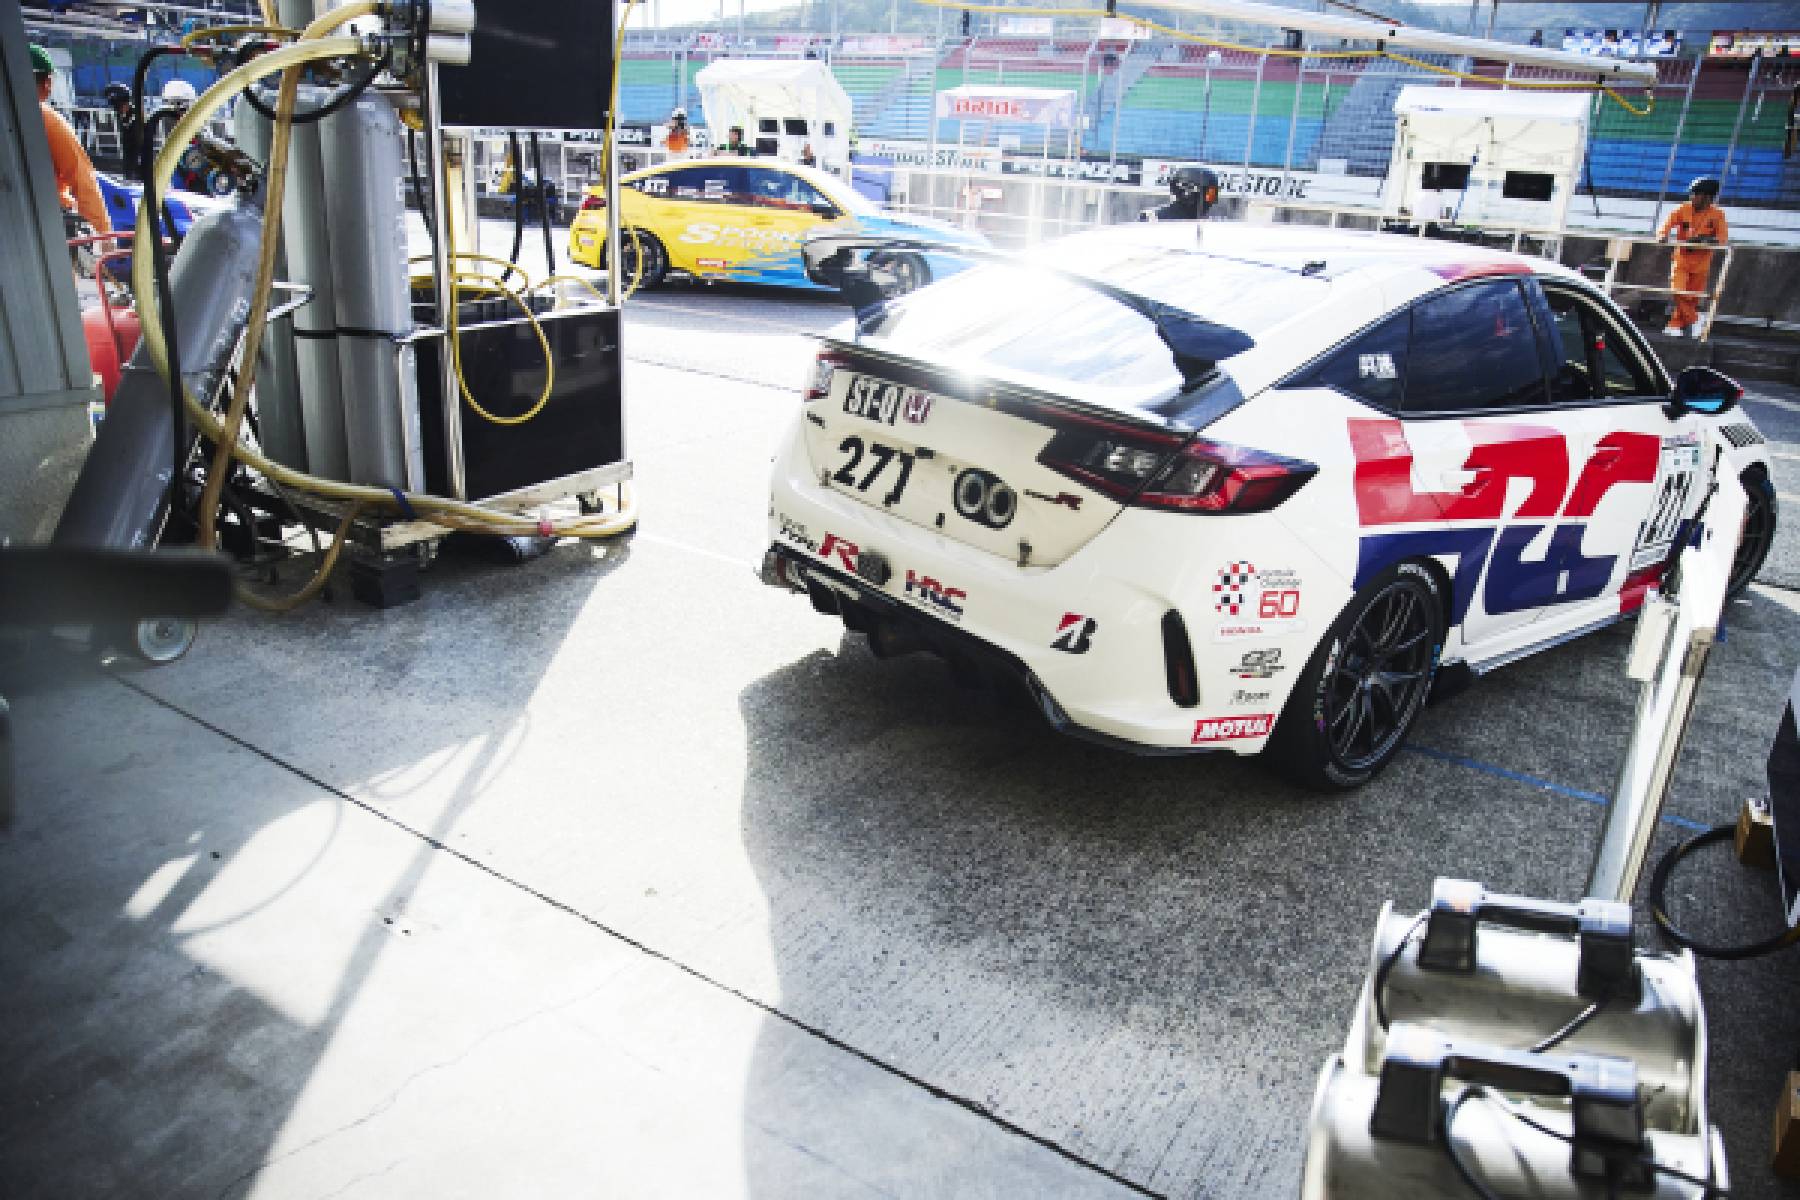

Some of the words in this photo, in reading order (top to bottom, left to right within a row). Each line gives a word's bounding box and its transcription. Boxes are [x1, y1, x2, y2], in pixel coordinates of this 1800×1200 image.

[833, 436, 917, 504] 271
[818, 531, 858, 574] R
[905, 570, 967, 615] HRC
[1258, 590, 1300, 619] 60
[1199, 720, 1268, 739] MOTUL
